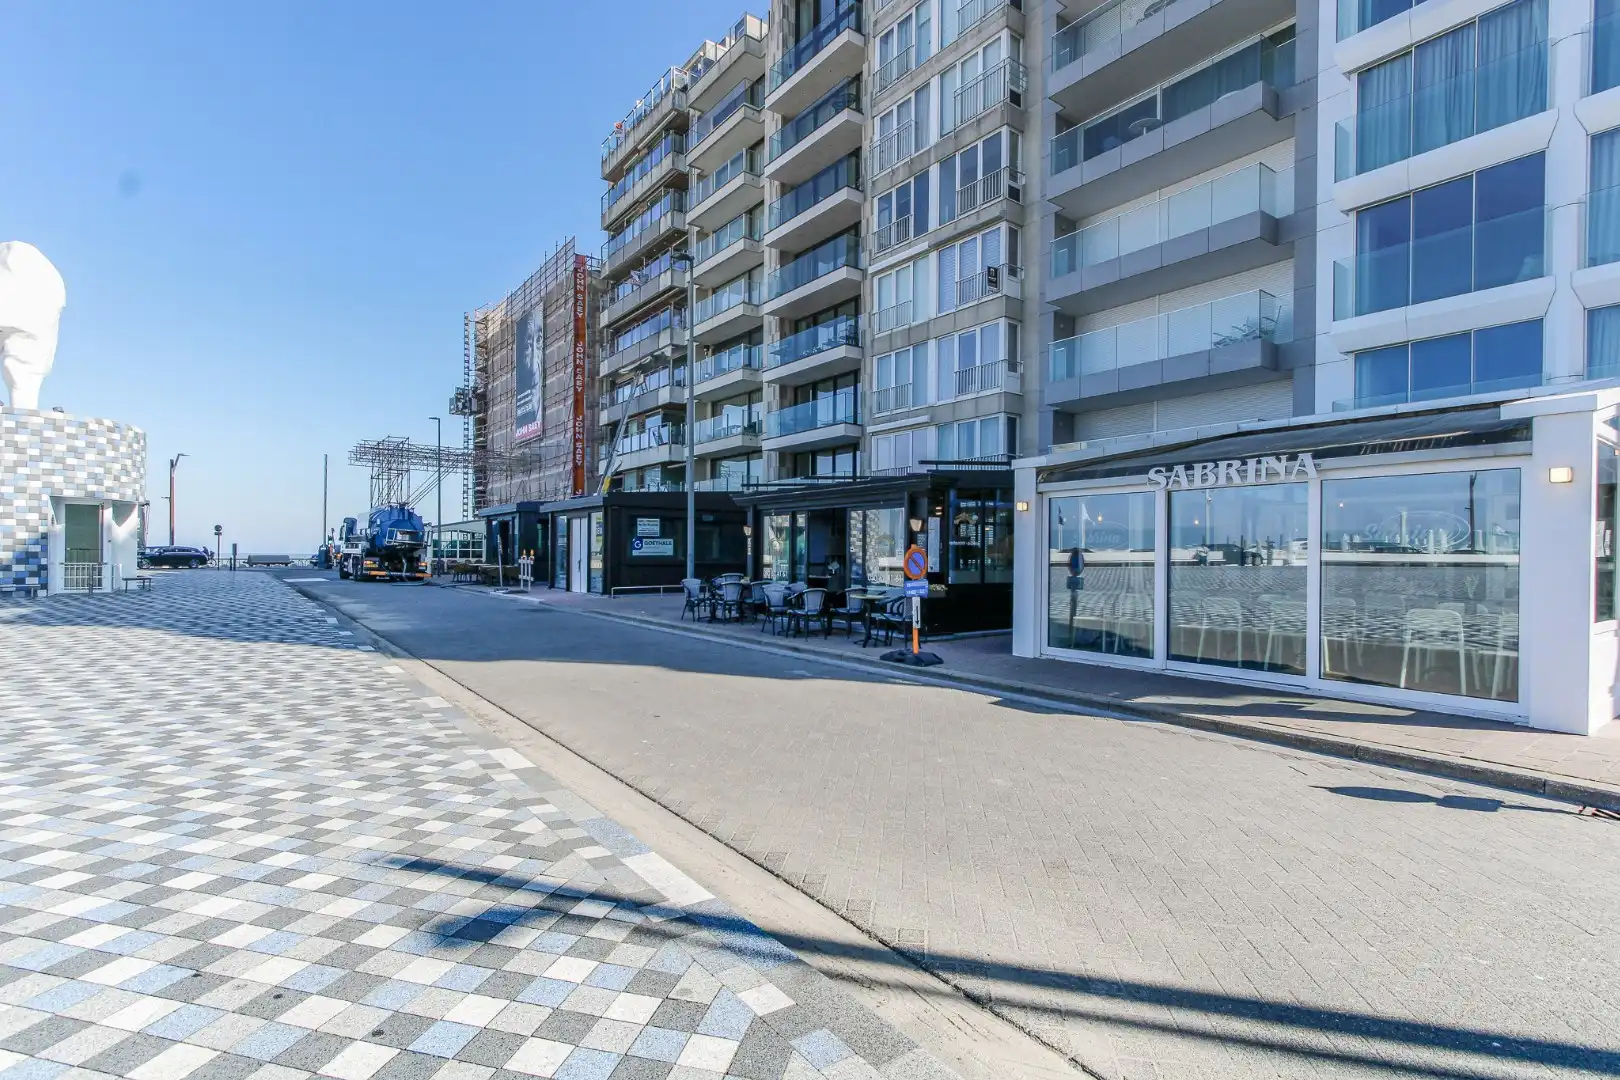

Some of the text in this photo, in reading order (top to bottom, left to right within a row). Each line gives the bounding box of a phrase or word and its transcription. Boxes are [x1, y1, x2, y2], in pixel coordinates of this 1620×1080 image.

[576, 266, 585, 292] JOHN
[576, 341, 584, 366] JOHN
[515, 424, 528, 438] JOHN
[575, 415, 584, 439] JOHN
[1146, 452, 1319, 491] SABRINA
